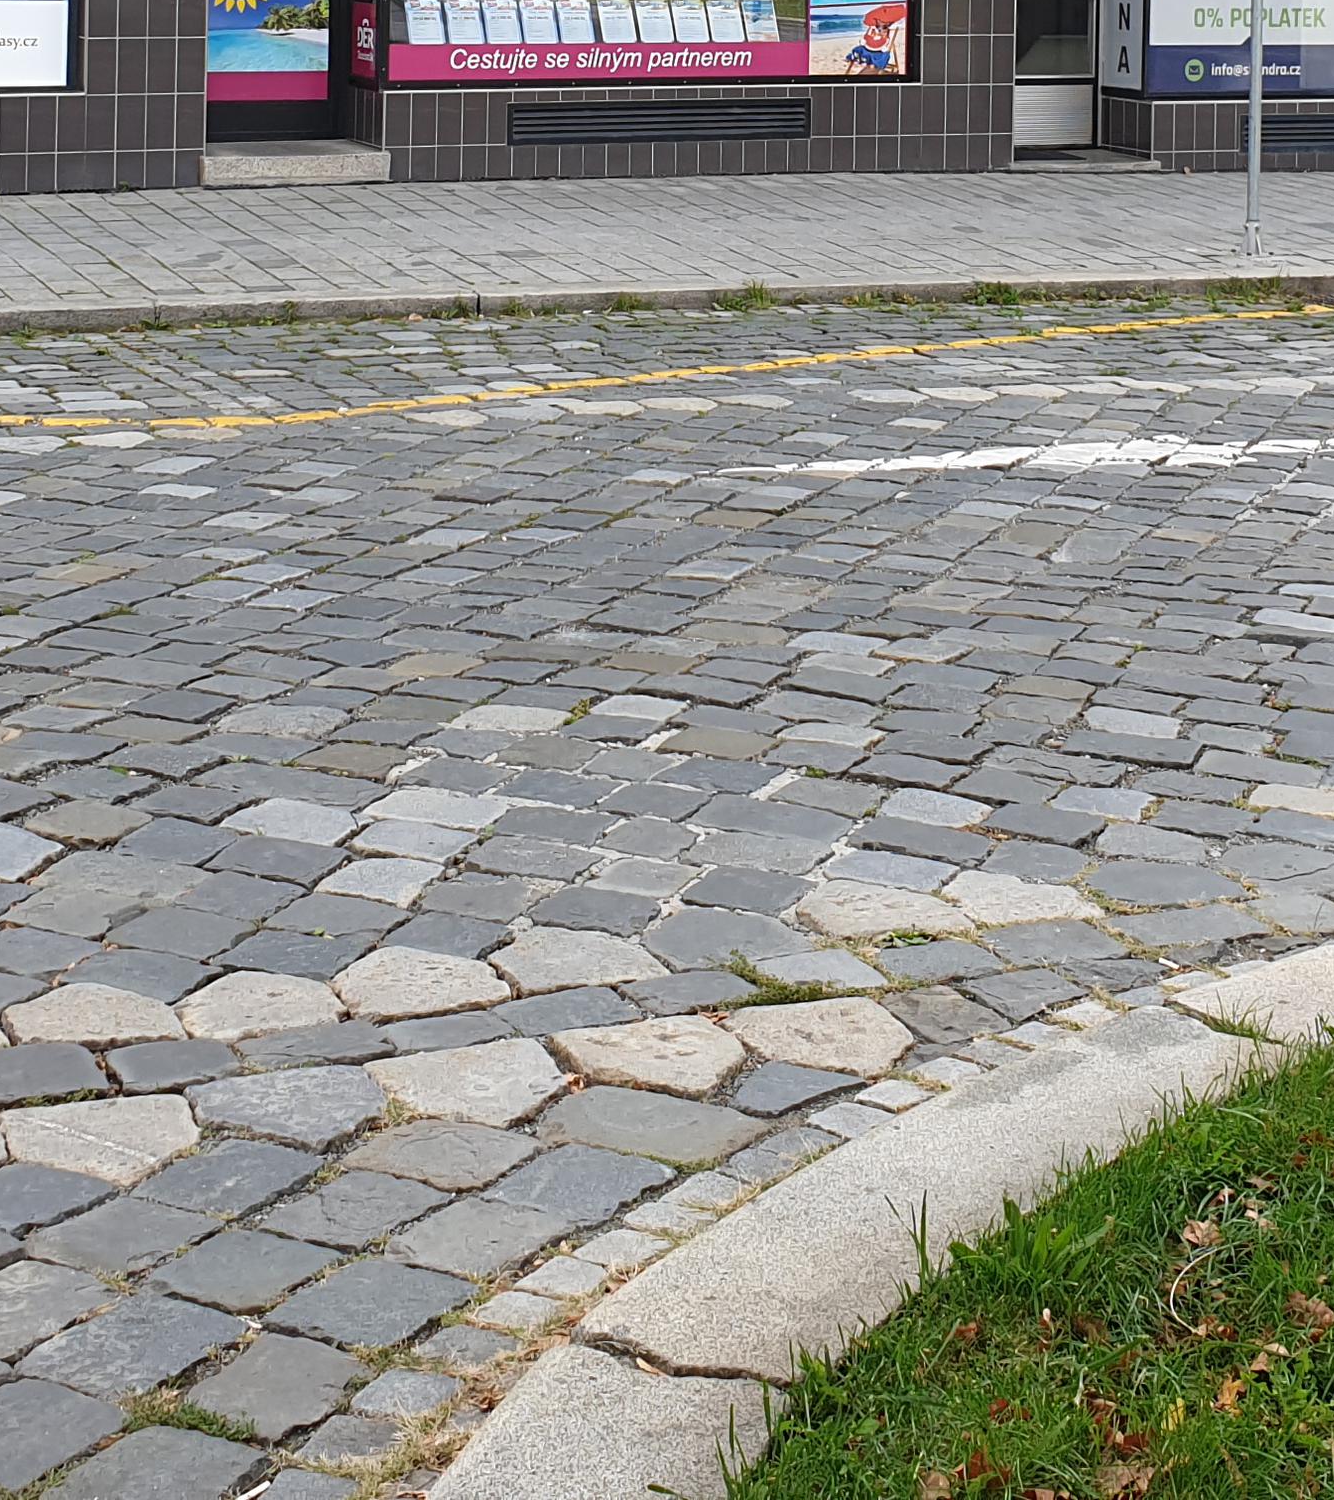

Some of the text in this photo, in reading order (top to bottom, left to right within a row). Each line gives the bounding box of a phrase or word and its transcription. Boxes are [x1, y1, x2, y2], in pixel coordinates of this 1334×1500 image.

[1194, 8, 1224, 28] 0%
[449, 47, 753, 74] Cestujte se silným partnerem
